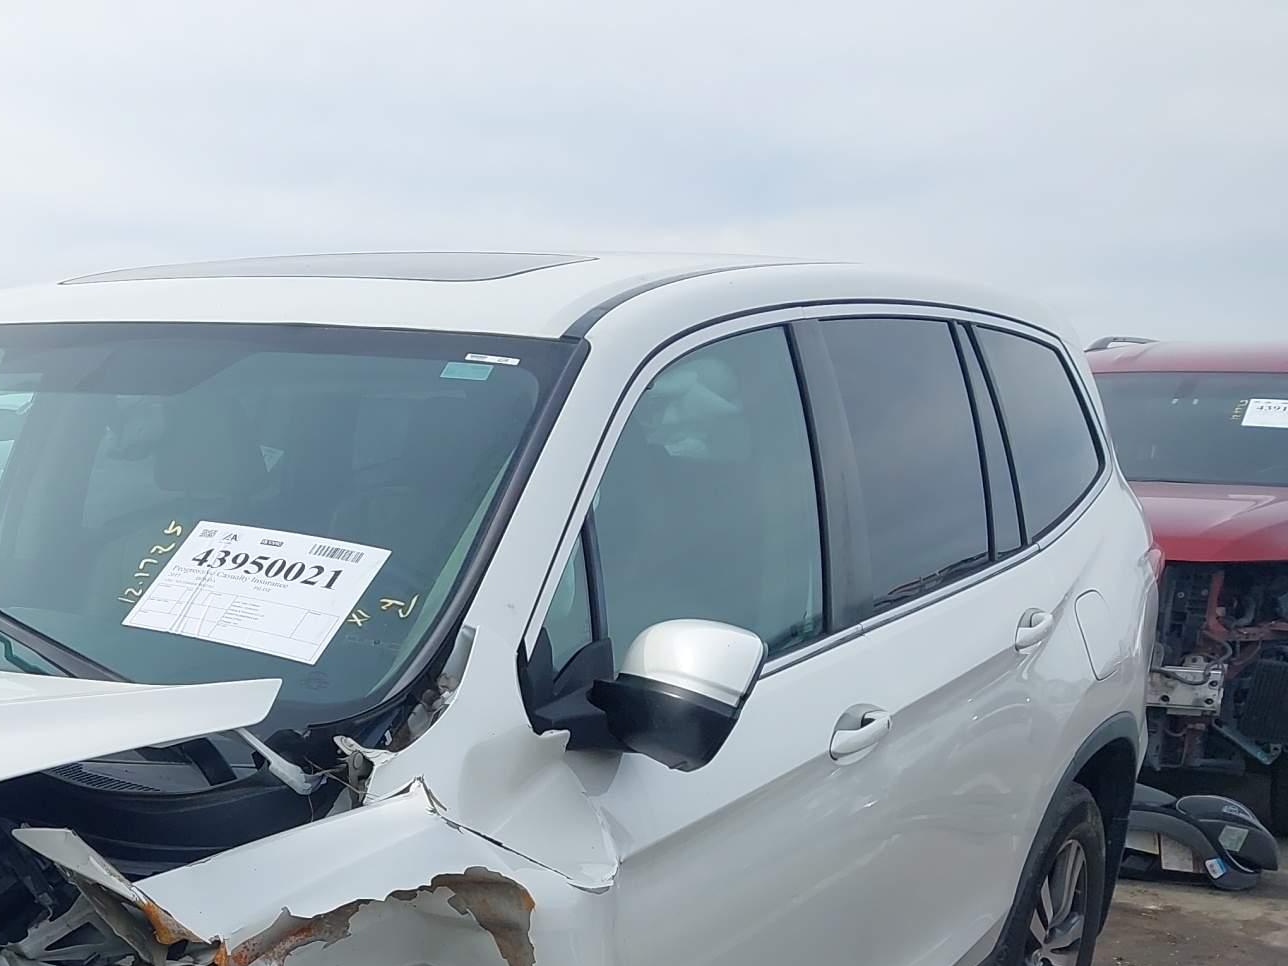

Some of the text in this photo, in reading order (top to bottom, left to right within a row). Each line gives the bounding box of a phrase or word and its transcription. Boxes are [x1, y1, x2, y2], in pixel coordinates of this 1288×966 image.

[191, 548, 344, 591] 43950021
[216, 571, 249, 583] Casualty
[251, 577, 289, 589] Insurance
